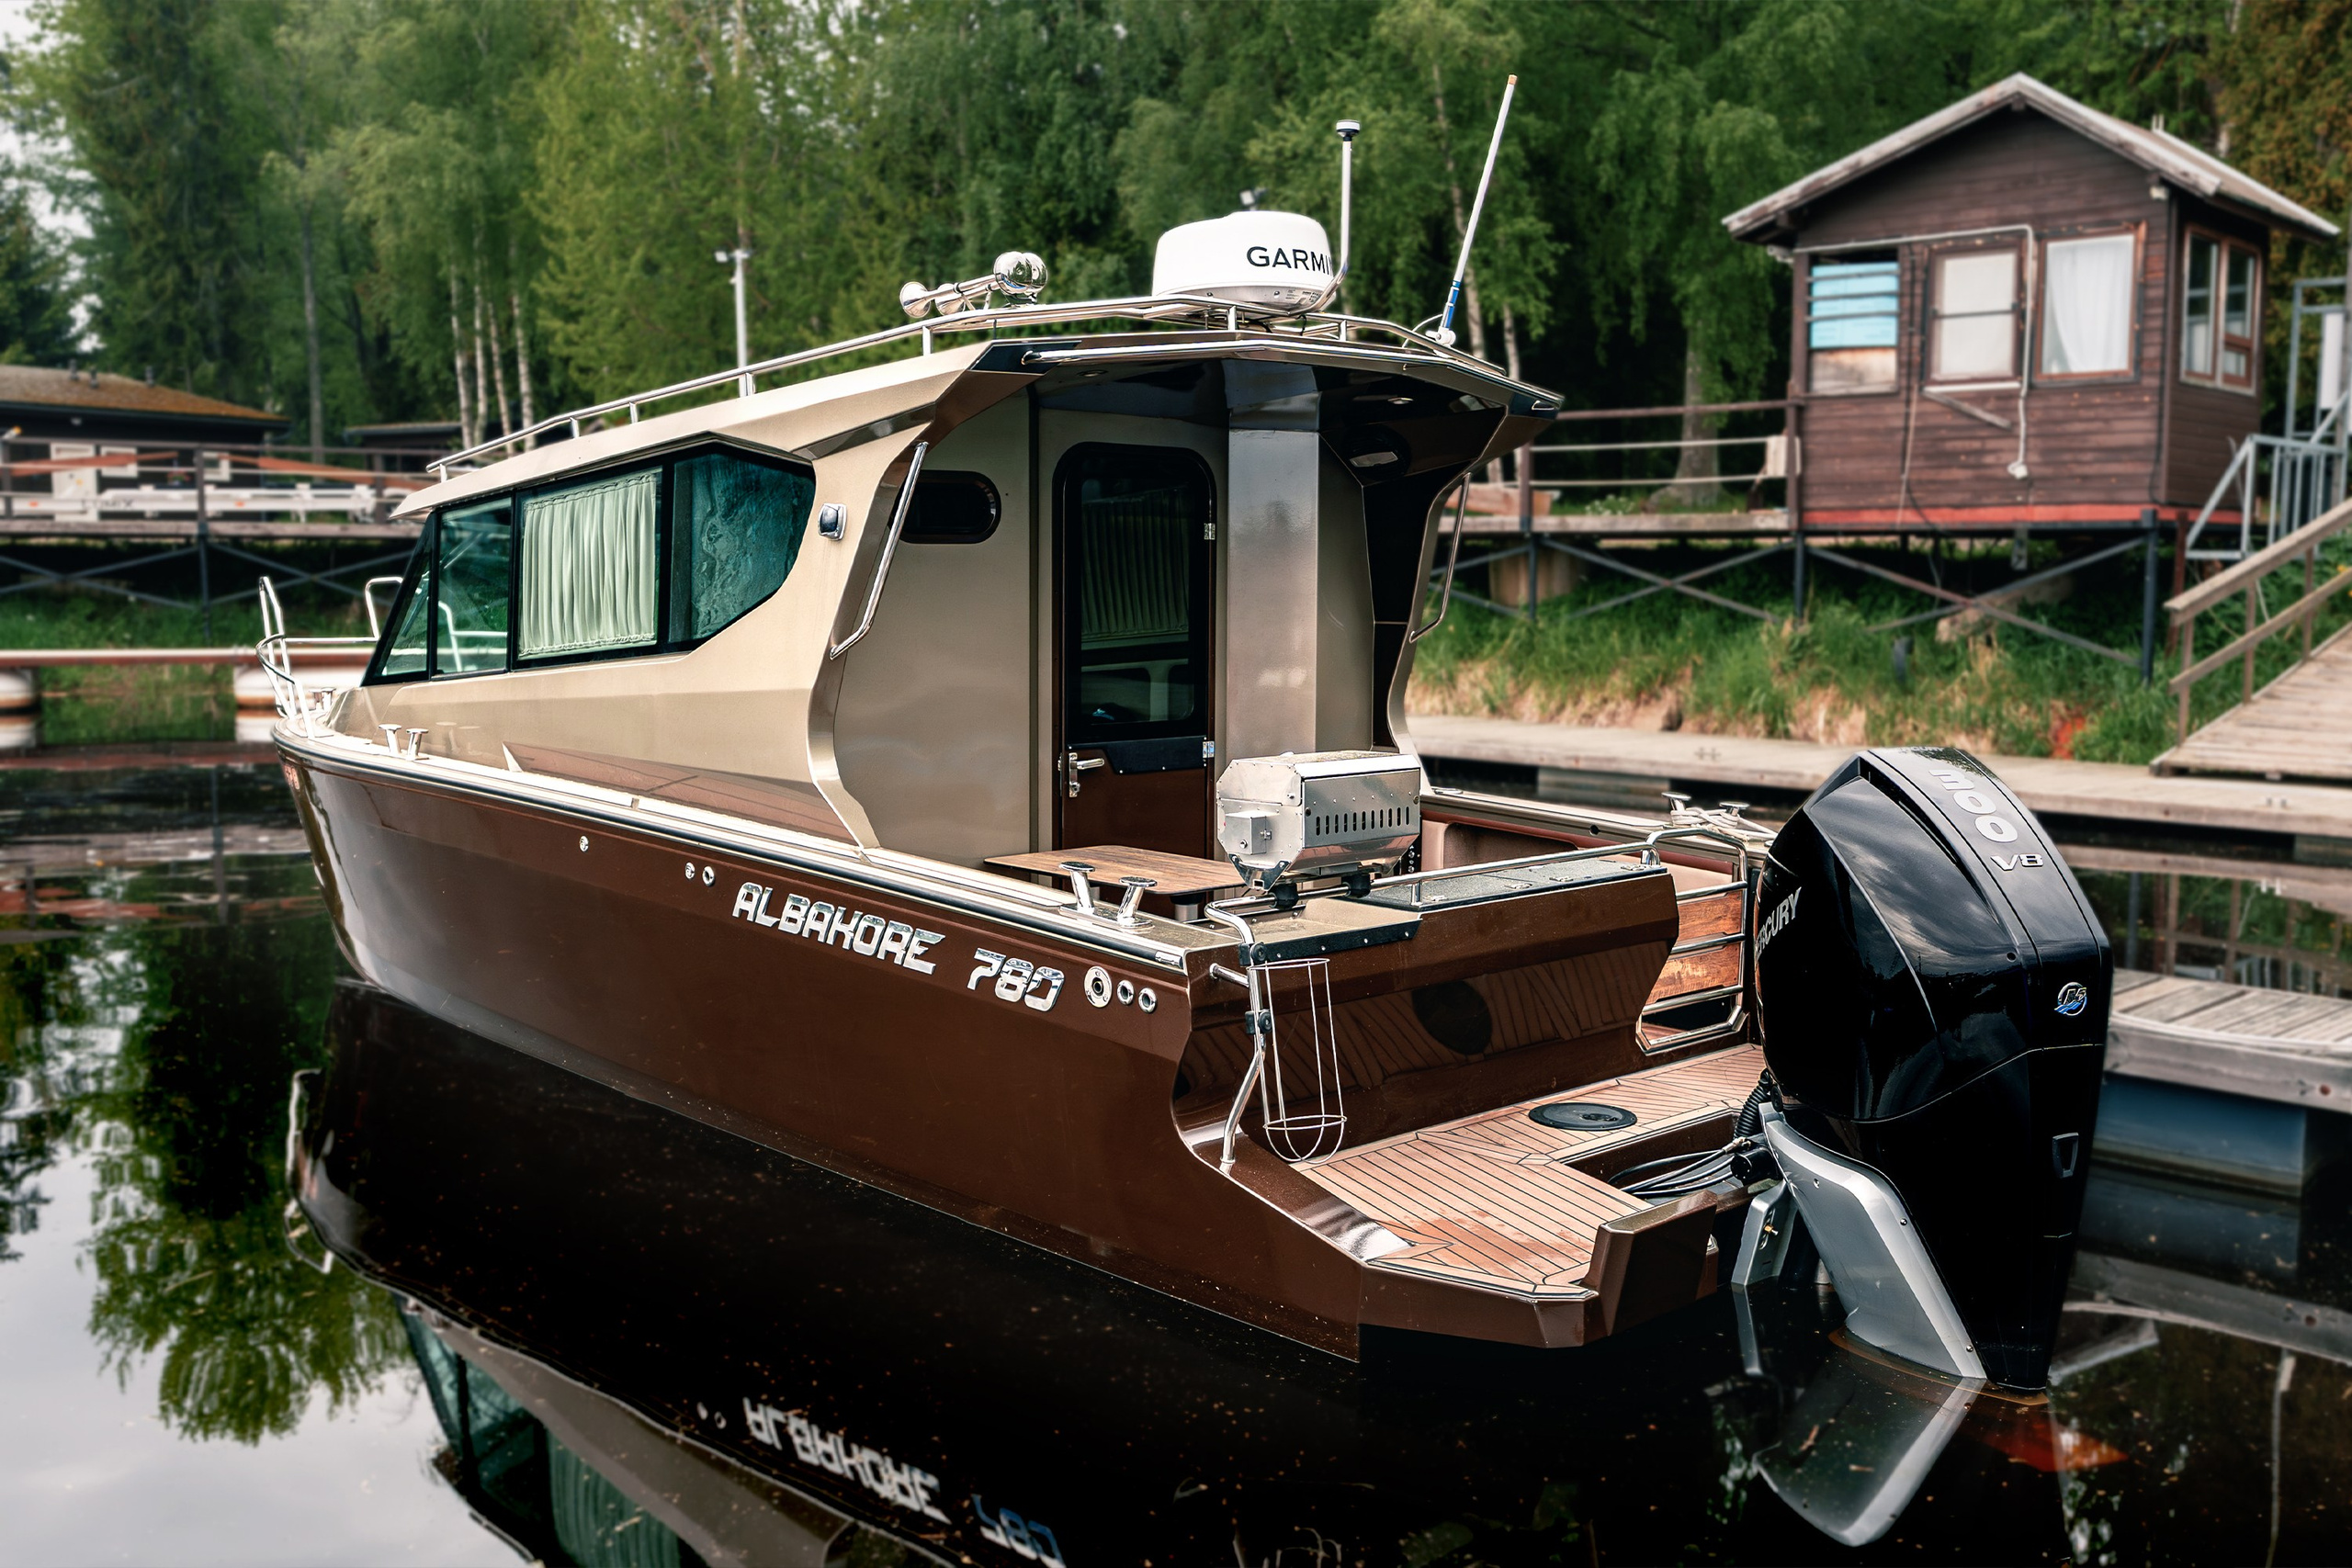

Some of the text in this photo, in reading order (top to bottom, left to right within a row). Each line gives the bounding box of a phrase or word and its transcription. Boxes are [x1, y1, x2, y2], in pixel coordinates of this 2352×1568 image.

[1928, 768, 2019, 843] 300
[1989, 852, 2045, 872] V8
[731, 881, 1065, 1012] ALBAKORE 780
